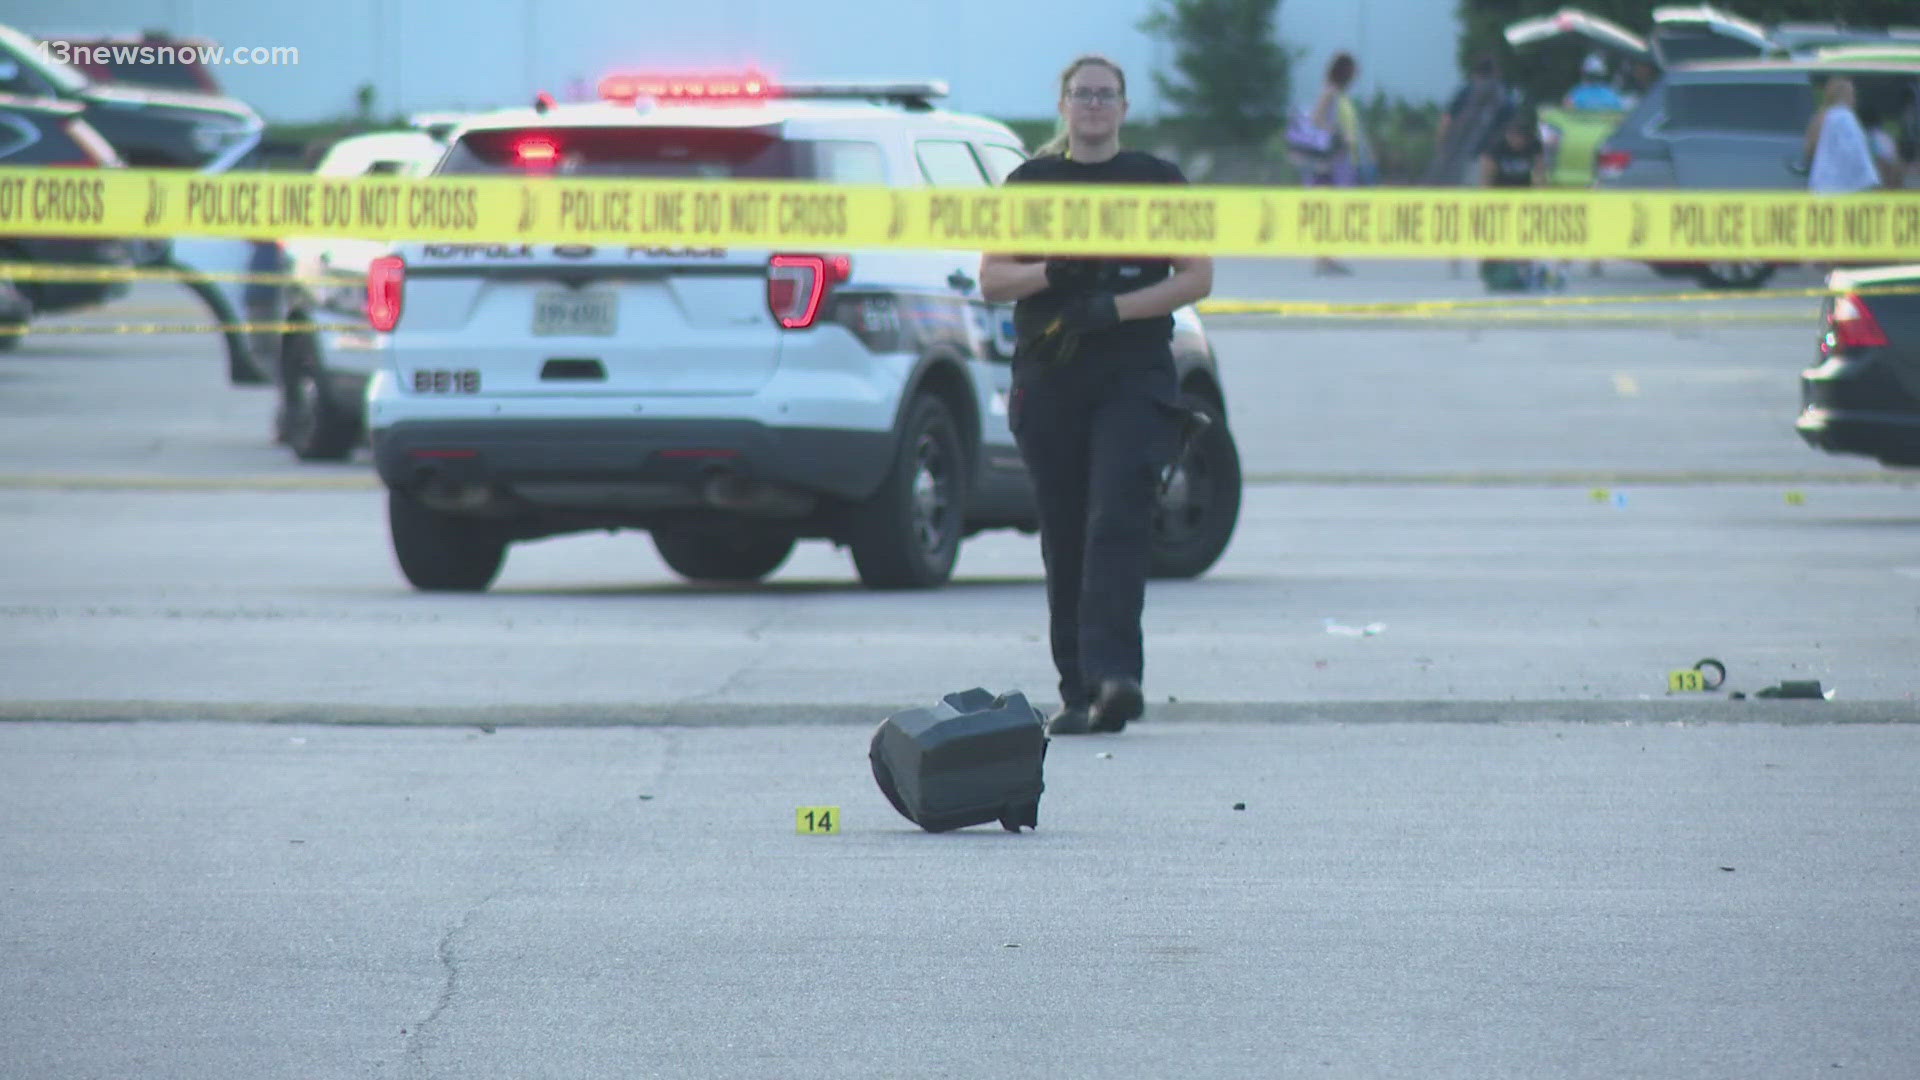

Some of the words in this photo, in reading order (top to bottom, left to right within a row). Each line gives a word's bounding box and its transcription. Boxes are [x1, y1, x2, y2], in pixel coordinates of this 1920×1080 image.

[33, 177, 105, 224] CROSS
[187, 180, 262, 226] POLICE
[268, 182, 315, 227] LINE
[322, 183, 352, 227] DO
[359, 184, 401, 228] NOT
[408, 185, 479, 230] CROSS
[559, 190, 632, 233] POLICE
[640, 191, 686, 233] LINE
[693, 191, 723, 234] DO
[730, 192, 771, 235] NOT
[778, 193, 849, 236] CROSS
[929, 194, 1000, 240] POLICE
[1009, 196, 1055, 240] LINE
[1062, 197, 1091, 240] DO
[1100, 197, 1140, 241] NOT
[1148, 197, 1217, 241] CROSS
[1299, 200, 1371, 243] POLICE
[1378, 201, 1426, 245] LINE
[1431, 202, 1459, 245] DO
[1468, 203, 1511, 246] NOT
[1517, 203, 1588, 246] CROSS
[1670, 202, 1746, 247] POLICE
[1751, 203, 1800, 248] LINE
[1805, 203, 1837, 247] DO
[1842, 203, 1888, 247] NOT
[1675, 674, 1697, 689] 13
[804, 810, 833, 832] 14
